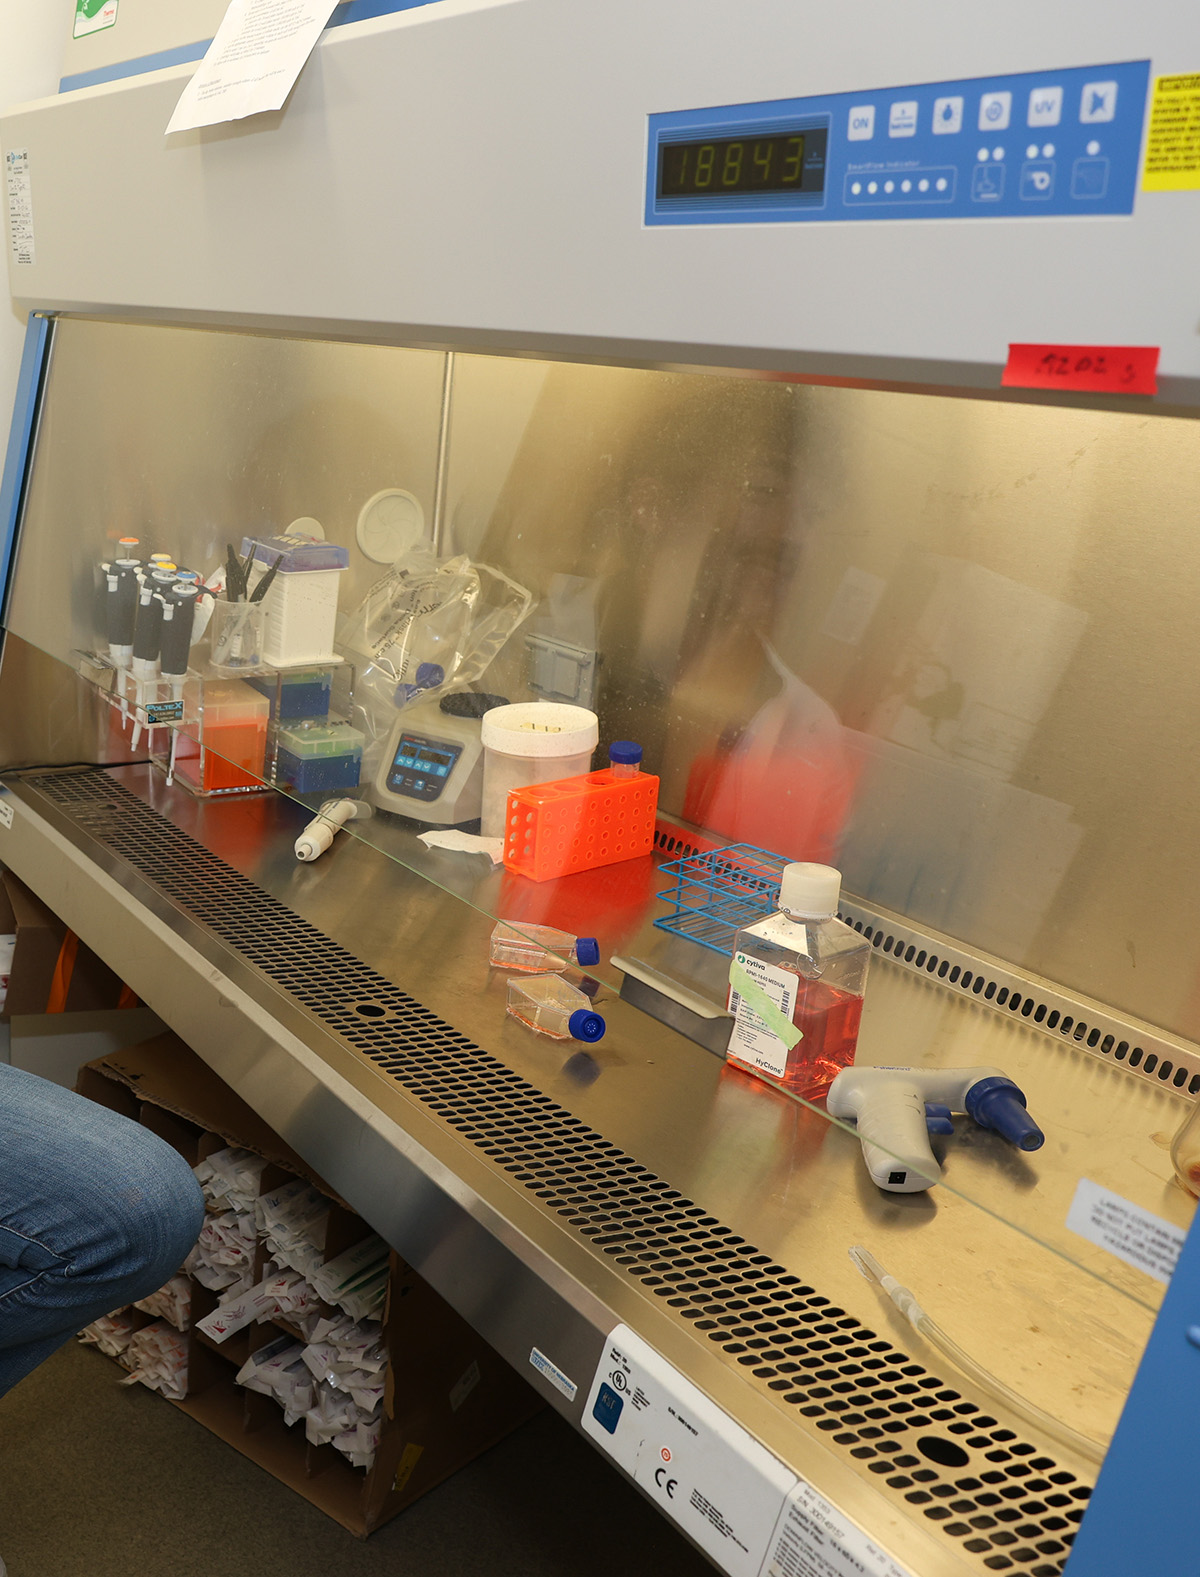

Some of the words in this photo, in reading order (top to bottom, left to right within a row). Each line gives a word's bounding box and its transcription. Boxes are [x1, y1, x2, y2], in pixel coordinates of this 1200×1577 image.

[1034, 100, 1056, 115] UV
[852, 117, 870, 131] ON
[680, 136, 804, 188] 18843
[746, 959, 766, 971] cytiva
